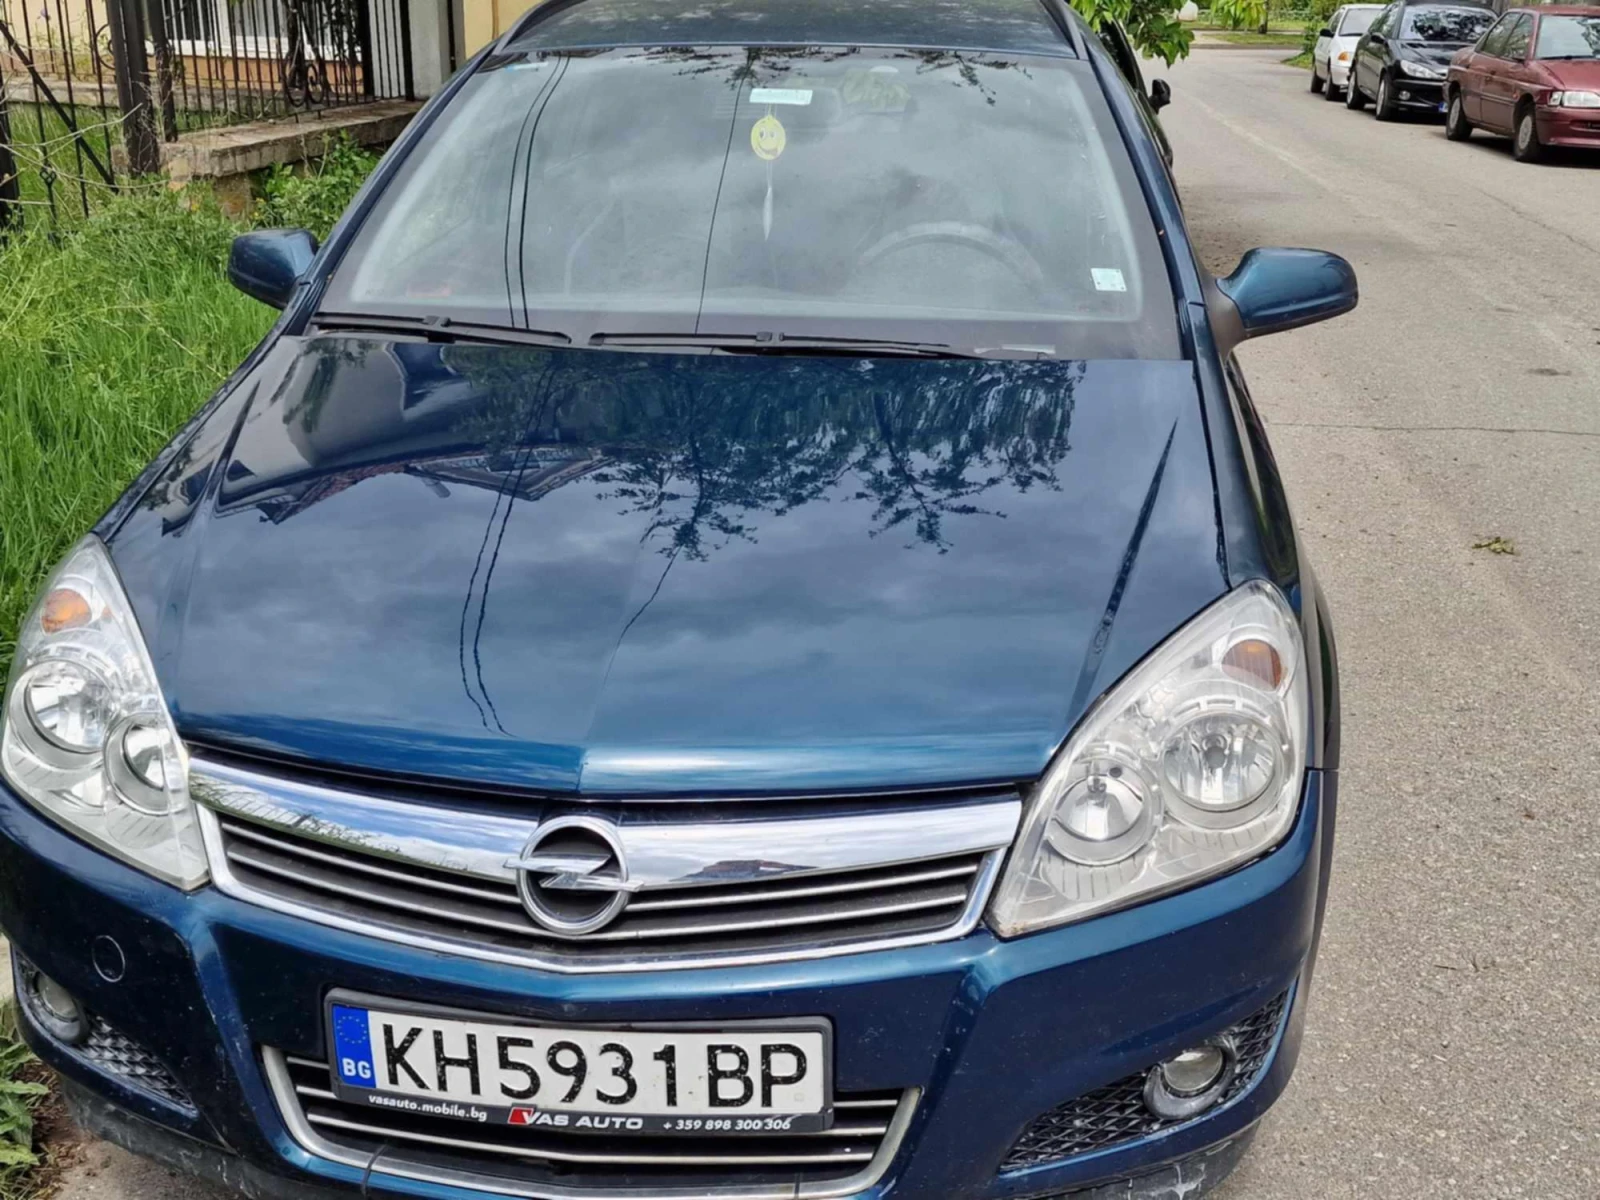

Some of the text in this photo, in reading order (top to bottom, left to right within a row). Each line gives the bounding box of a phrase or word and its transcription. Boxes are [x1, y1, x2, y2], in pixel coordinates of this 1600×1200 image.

[342, 1057, 371, 1079] BG
[368, 1094, 488, 1122] vasauto.mobile.bg
[521, 1111, 644, 1130] VAS AUTO
[675, 1119, 702, 1131] 359
[704, 1119, 732, 1131] 898
[734, 1119, 762, 1131] 300
[763, 1118, 792, 1131] 306
